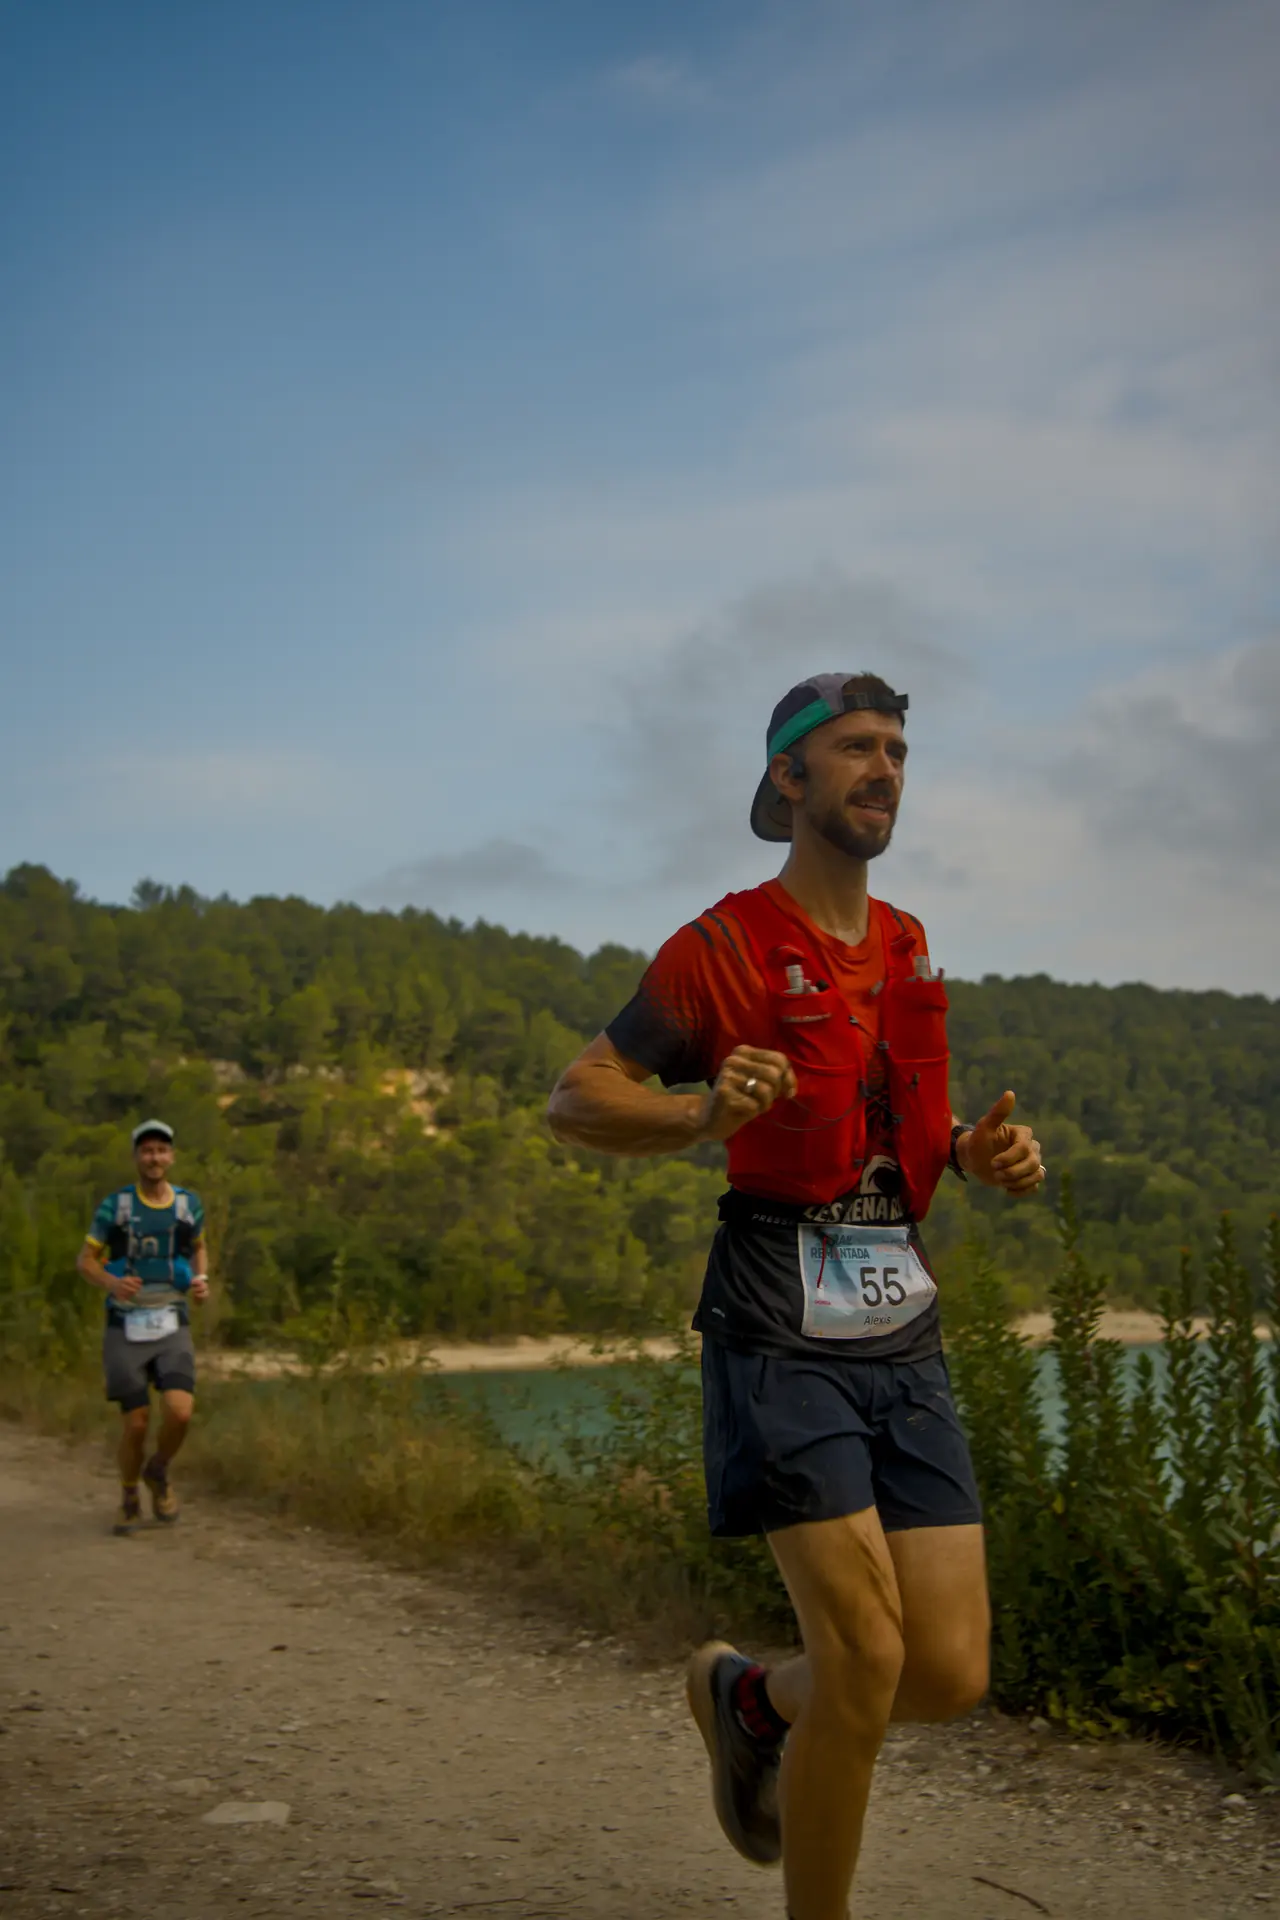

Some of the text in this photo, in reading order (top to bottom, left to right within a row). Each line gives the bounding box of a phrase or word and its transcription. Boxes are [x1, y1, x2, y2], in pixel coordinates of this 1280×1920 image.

[810, 1247, 870, 1259] REMNTADA
[860, 1267, 907, 1307] 55
[863, 1314, 891, 1325] Alexis
